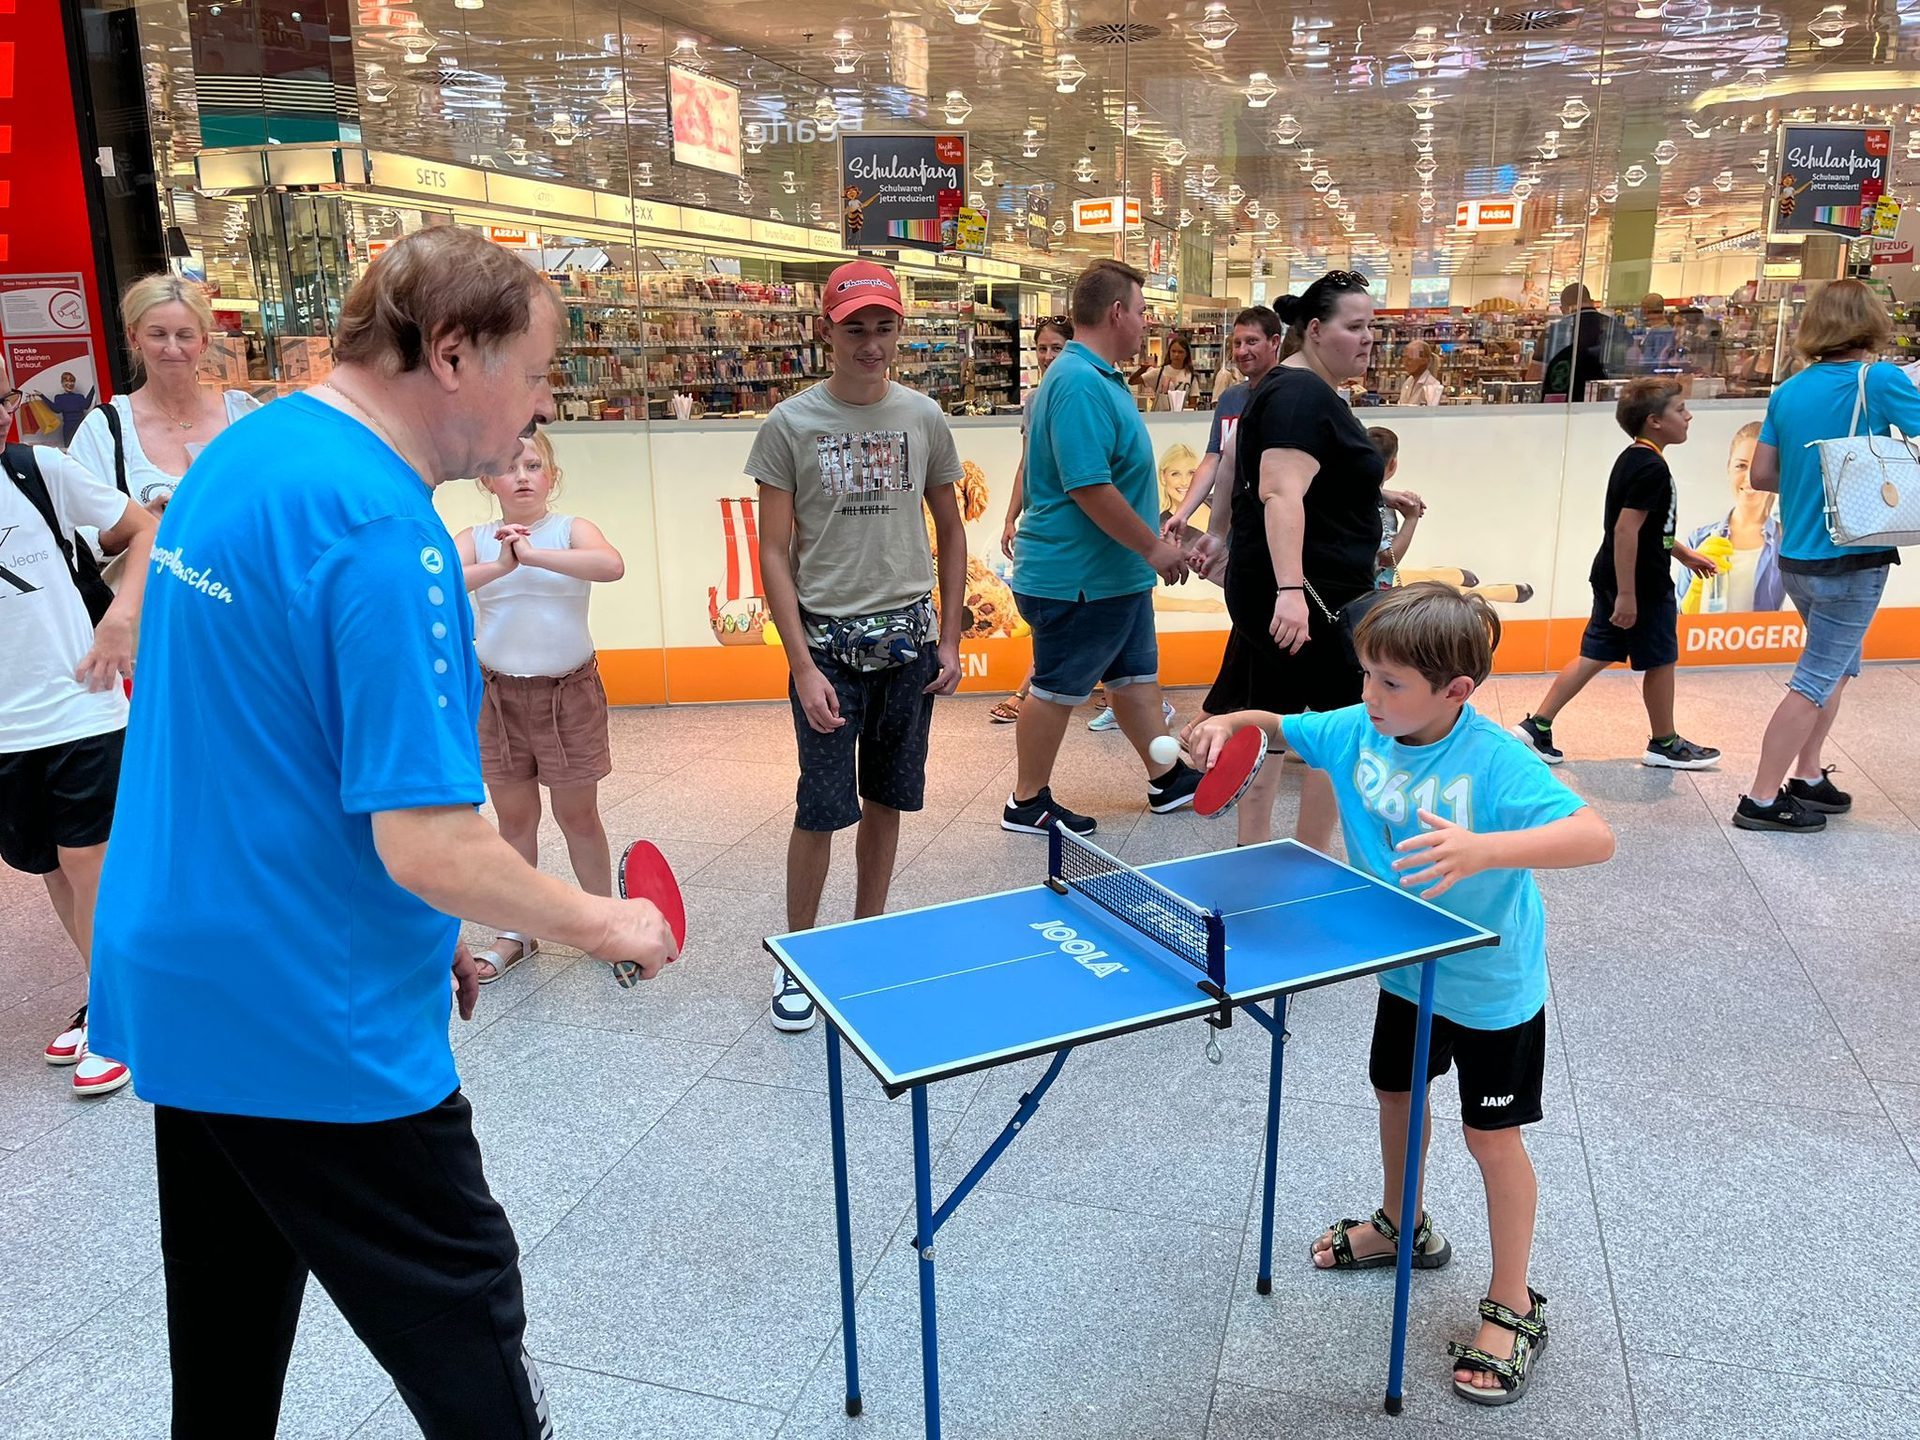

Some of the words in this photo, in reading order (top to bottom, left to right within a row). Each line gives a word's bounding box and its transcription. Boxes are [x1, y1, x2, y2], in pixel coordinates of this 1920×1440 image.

[1787, 145, 1881, 179] Schulanfang
[416, 167, 447, 188] SETS
[848, 154, 957, 189] Schulanfang
[1812, 173, 1850, 181] Schulwaren
[879, 184, 923, 193] Schulwaren
[1811, 183, 1826, 191] jetzt
[1827, 182, 1860, 191] reduziert!
[879, 195, 897, 204] jetzt
[898, 194, 935, 203] reduziert!
[1080, 209, 1110, 220] KASSA
[1480, 209, 1511, 219] KASSA
[836, 278, 893, 293] Champion
[841, 505, 857, 516] WILL
[859, 504, 879, 516] NEVER
[9, 549, 49, 569] Jeans
[1028, 920, 1125, 979] JOOLA
[1480, 1094, 1514, 1107] JAKO
